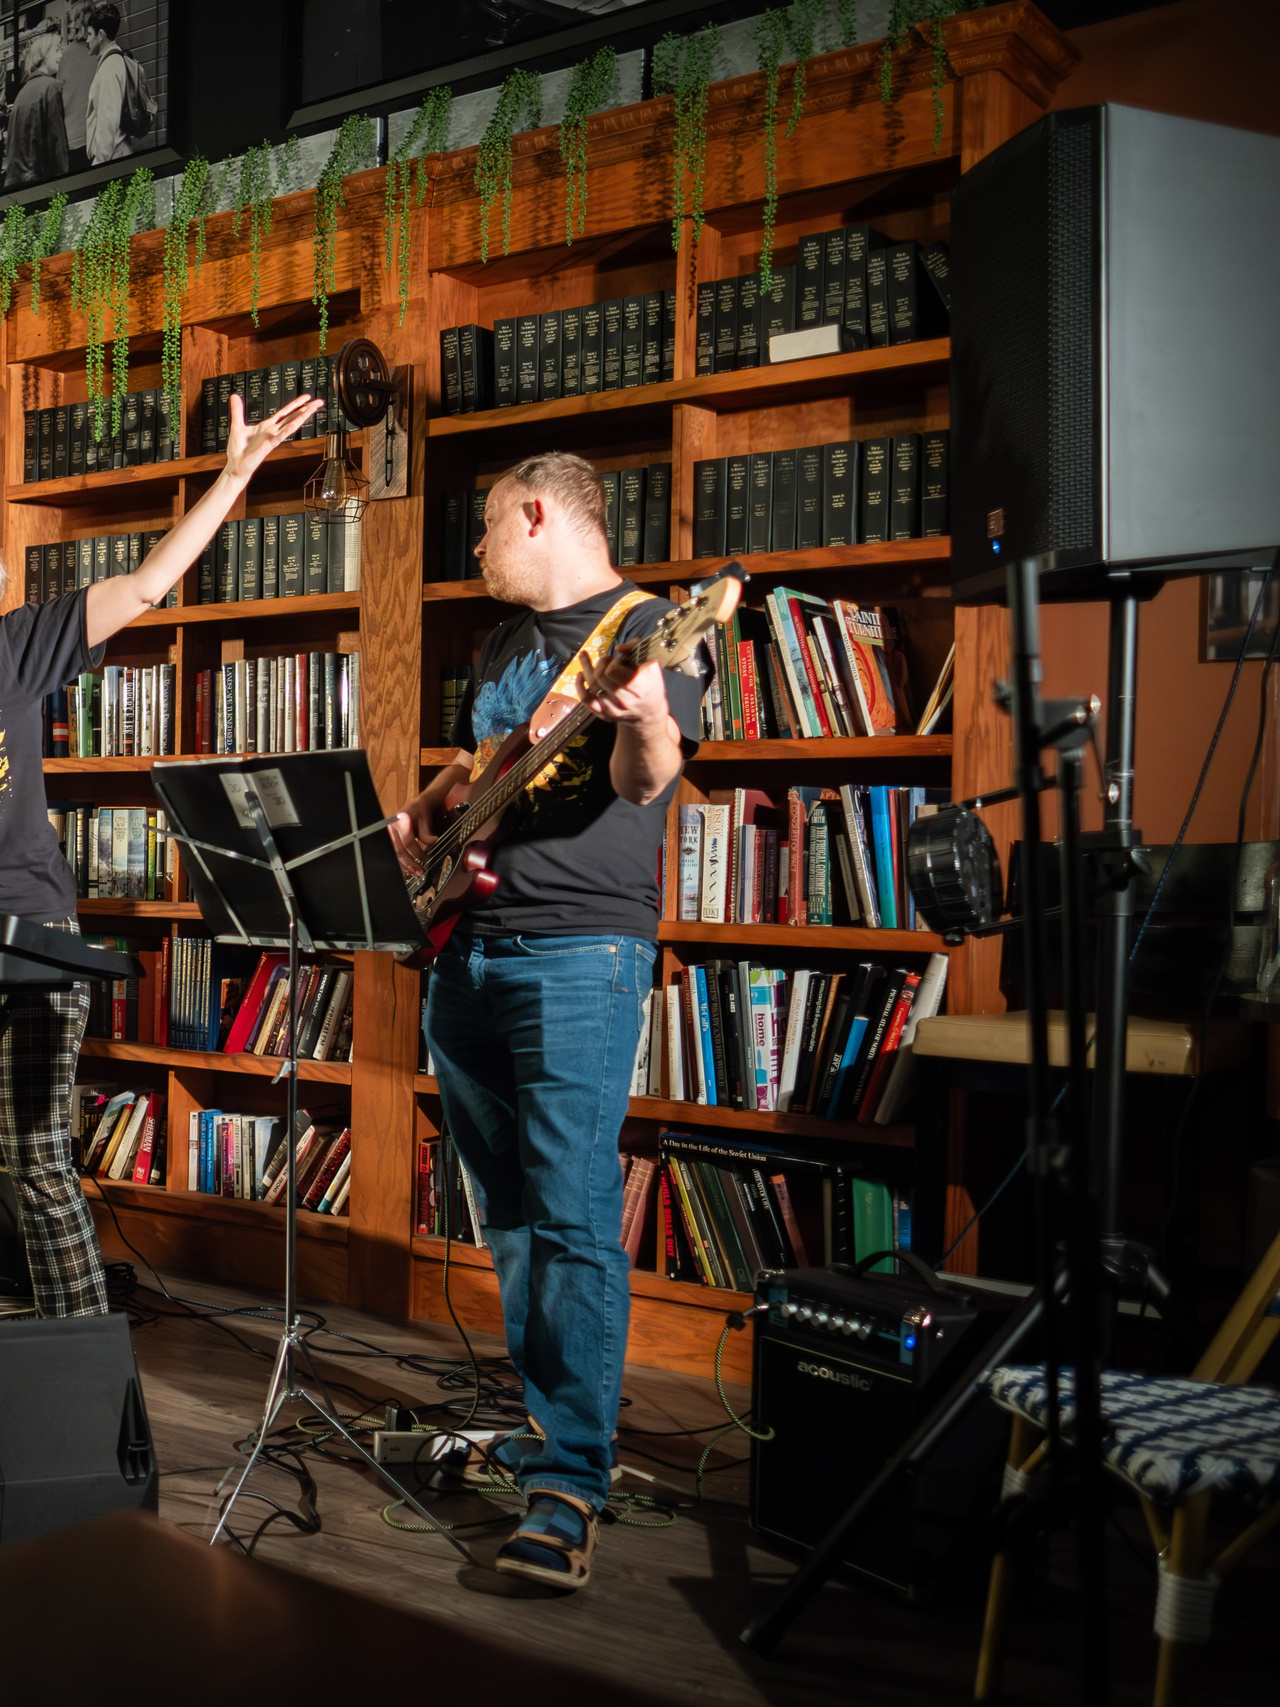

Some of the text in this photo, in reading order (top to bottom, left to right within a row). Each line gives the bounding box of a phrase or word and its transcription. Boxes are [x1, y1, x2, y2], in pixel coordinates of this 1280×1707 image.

[746, 646, 754, 674] CUTTING
[800, 650, 810, 668] GRAPHIC
[807, 669, 818, 694] STANDARDS
[743, 692, 751, 724] VERGHESE
[680, 826, 699, 835] NEW
[706, 807, 714, 837] SCIENCE
[713, 808, 722, 838] VISUAL
[811, 816, 825, 824] SMITH
[815, 826, 827, 839] THE
[680, 836, 699, 844] YORK
[790, 805, 799, 873] CONQUEST OF SPACE
[815, 839, 827, 864] FRUGAL
[814, 864, 827, 896] GOURMET
[705, 908, 717, 917] DK
[707, 969, 717, 1001] MATHEW
[710, 1002, 718, 1026] BRADY
[882, 989, 897, 1017] PICTORIAL
[319, 1006, 336, 1046] JERUSALEM
[757, 1013, 766, 1047] home
[790, 999, 803, 1045] GREAT AMERICAN
[876, 1018, 887, 1034] ATLAS
[829, 1053, 842, 1068] ART
[867, 1040, 880, 1060] NORTH
[716, 1060, 724, 1087] WORLD
[142, 1117, 156, 1153] SHERMAN
[669, 1140, 681, 1149] Day
[688, 1143, 698, 1151] the
[698, 1144, 711, 1152] Life
[718, 1148, 729, 1156] the
[729, 1149, 747, 1158] Soviet
[748, 1153, 767, 1162] Union
[272, 1177, 286, 1194] FRONT
[666, 1238, 675, 1257] OUT
[797, 1360, 871, 1391] acoustic
